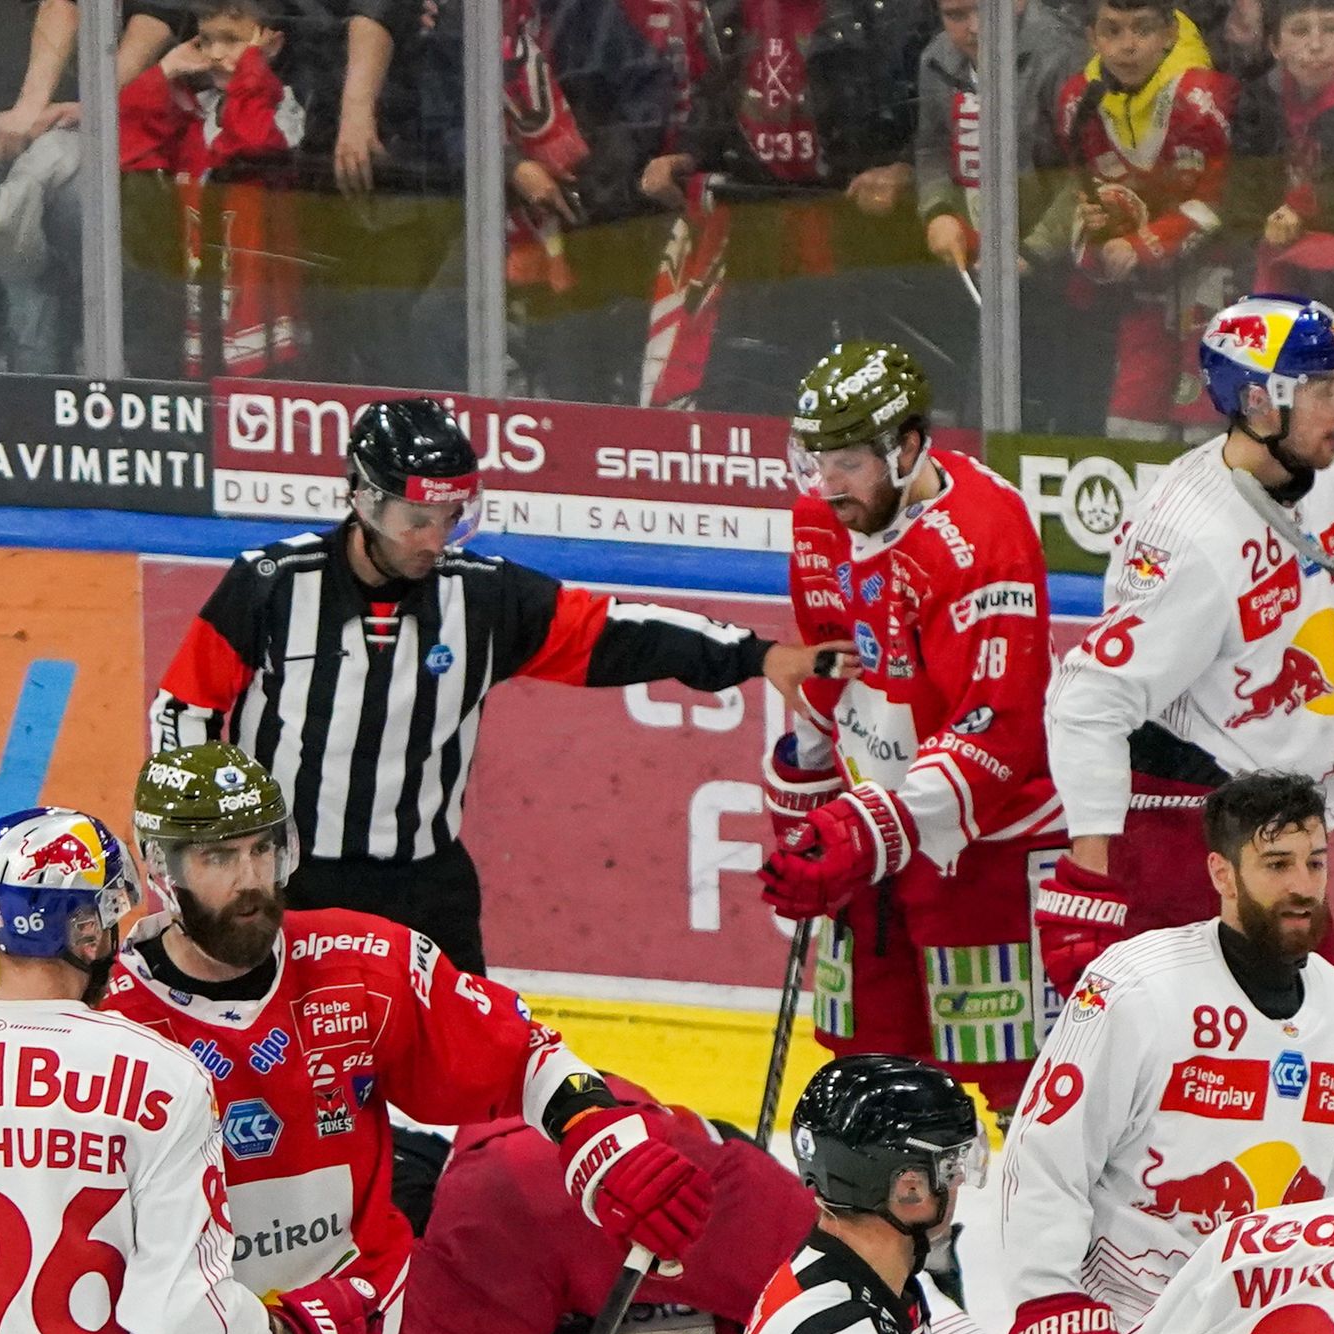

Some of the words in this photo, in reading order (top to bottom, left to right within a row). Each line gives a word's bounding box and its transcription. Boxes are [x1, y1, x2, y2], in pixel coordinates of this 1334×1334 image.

[835, 354, 888, 399] FORST
[54, 382, 204, 434] BÖDEN
[589, 507, 740, 539] SAUNEN
[1241, 526, 1283, 583] 26
[146, 763, 198, 791] FORST
[218, 789, 262, 813] FORST
[13, 912, 45, 935] 96
[291, 932, 391, 961] alperia
[320, 1000, 351, 1015] lebe
[312, 1011, 368, 1036] Fairpl
[1192, 1004, 1248, 1051] 89
[249, 1027, 290, 1074] elpo
[1197, 1068, 1225, 1085] lebe
[1273, 1063, 1305, 1088] ICE
[1183, 1083, 1256, 1111] Fairplay
[223, 1113, 274, 1147] ICE
[316, 1117, 355, 1137] FOXES
